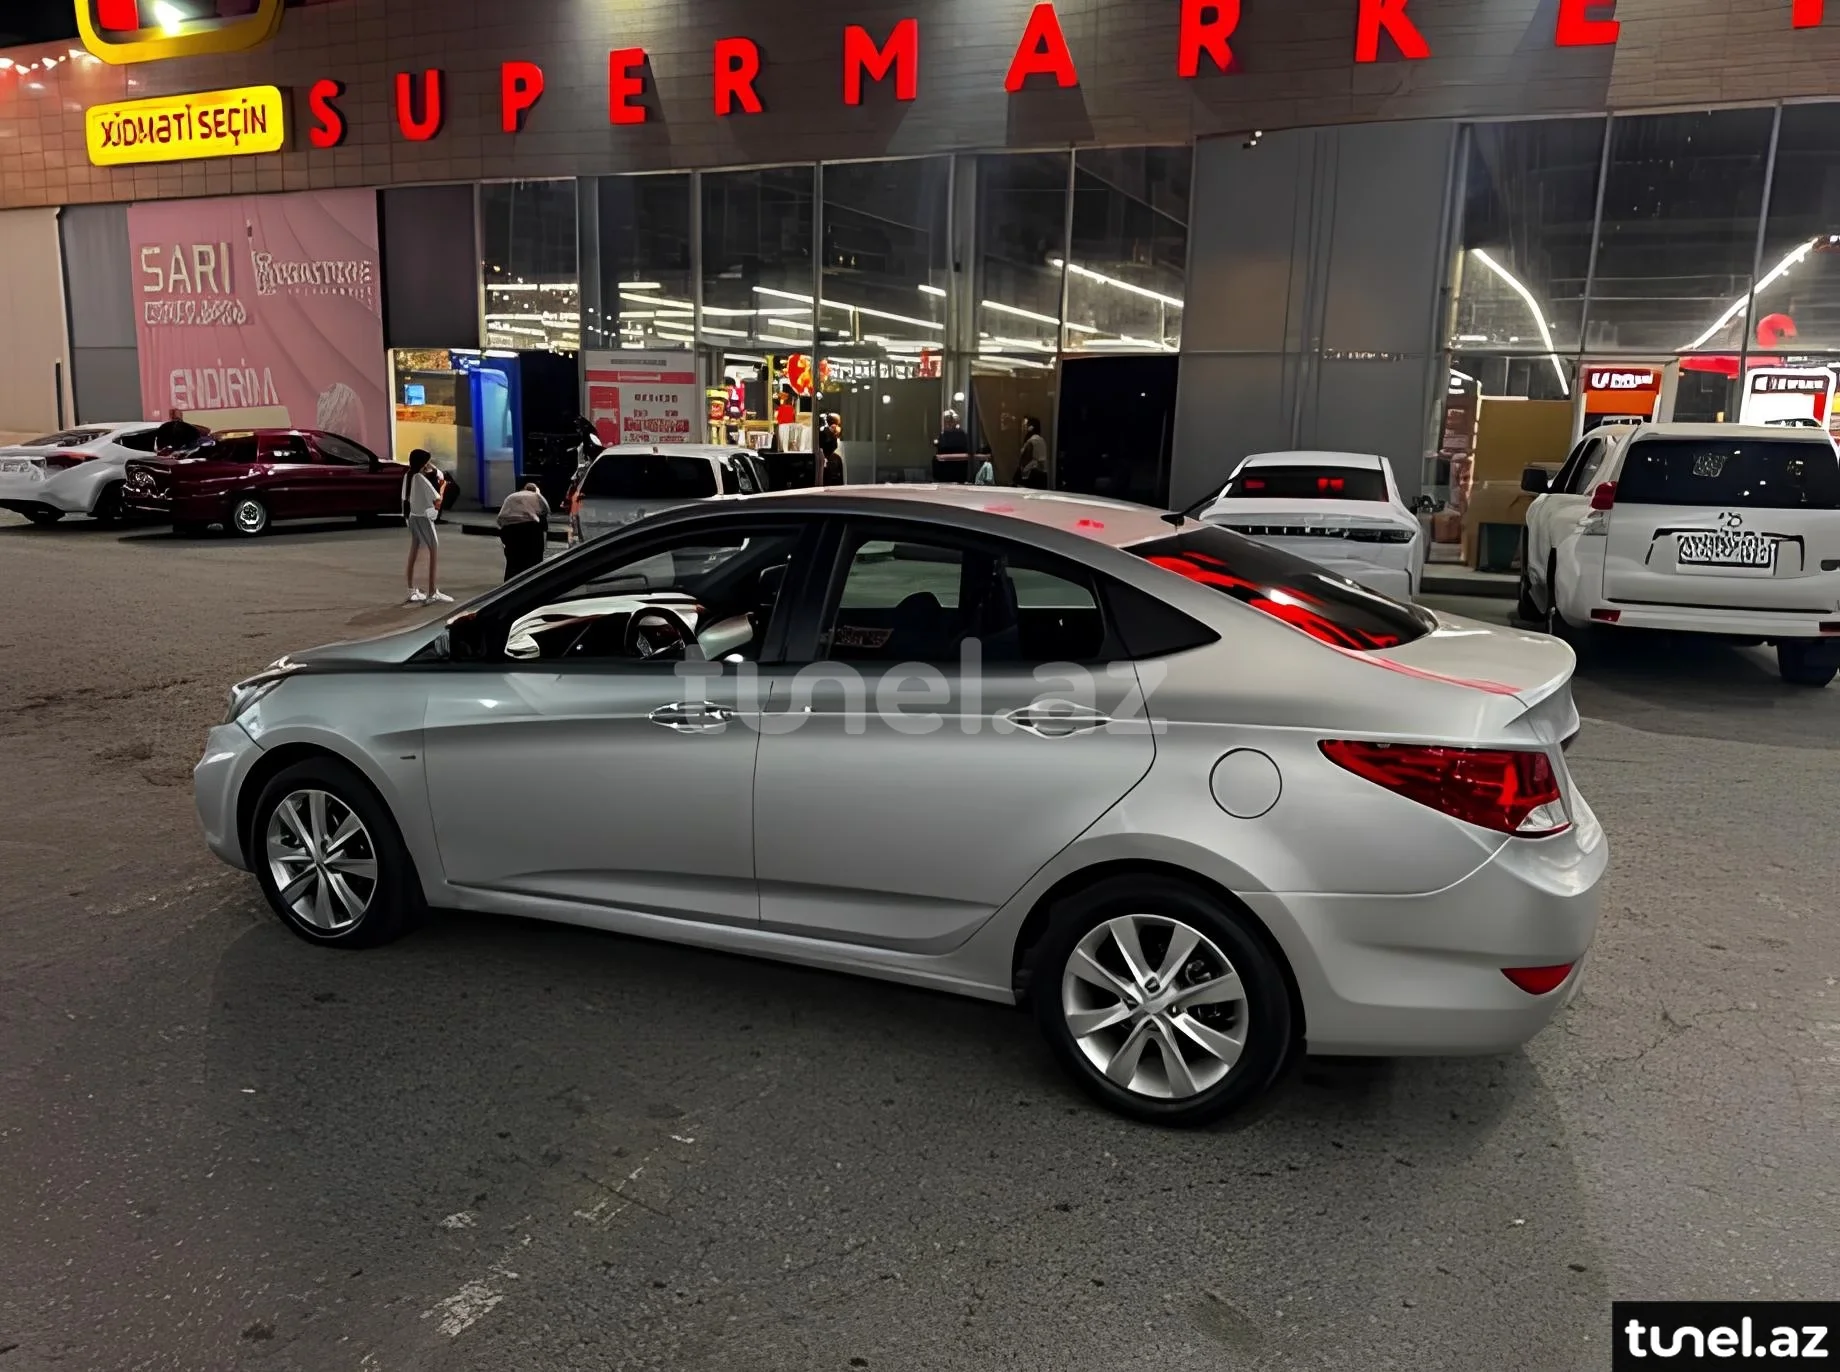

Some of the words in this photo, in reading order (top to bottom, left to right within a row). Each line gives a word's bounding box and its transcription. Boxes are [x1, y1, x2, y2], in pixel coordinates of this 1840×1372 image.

[309, 0, 1823, 149] SUPERMARKE
[197, 98, 268, 147] SEÇİN
[140, 241, 232, 294] SARI
